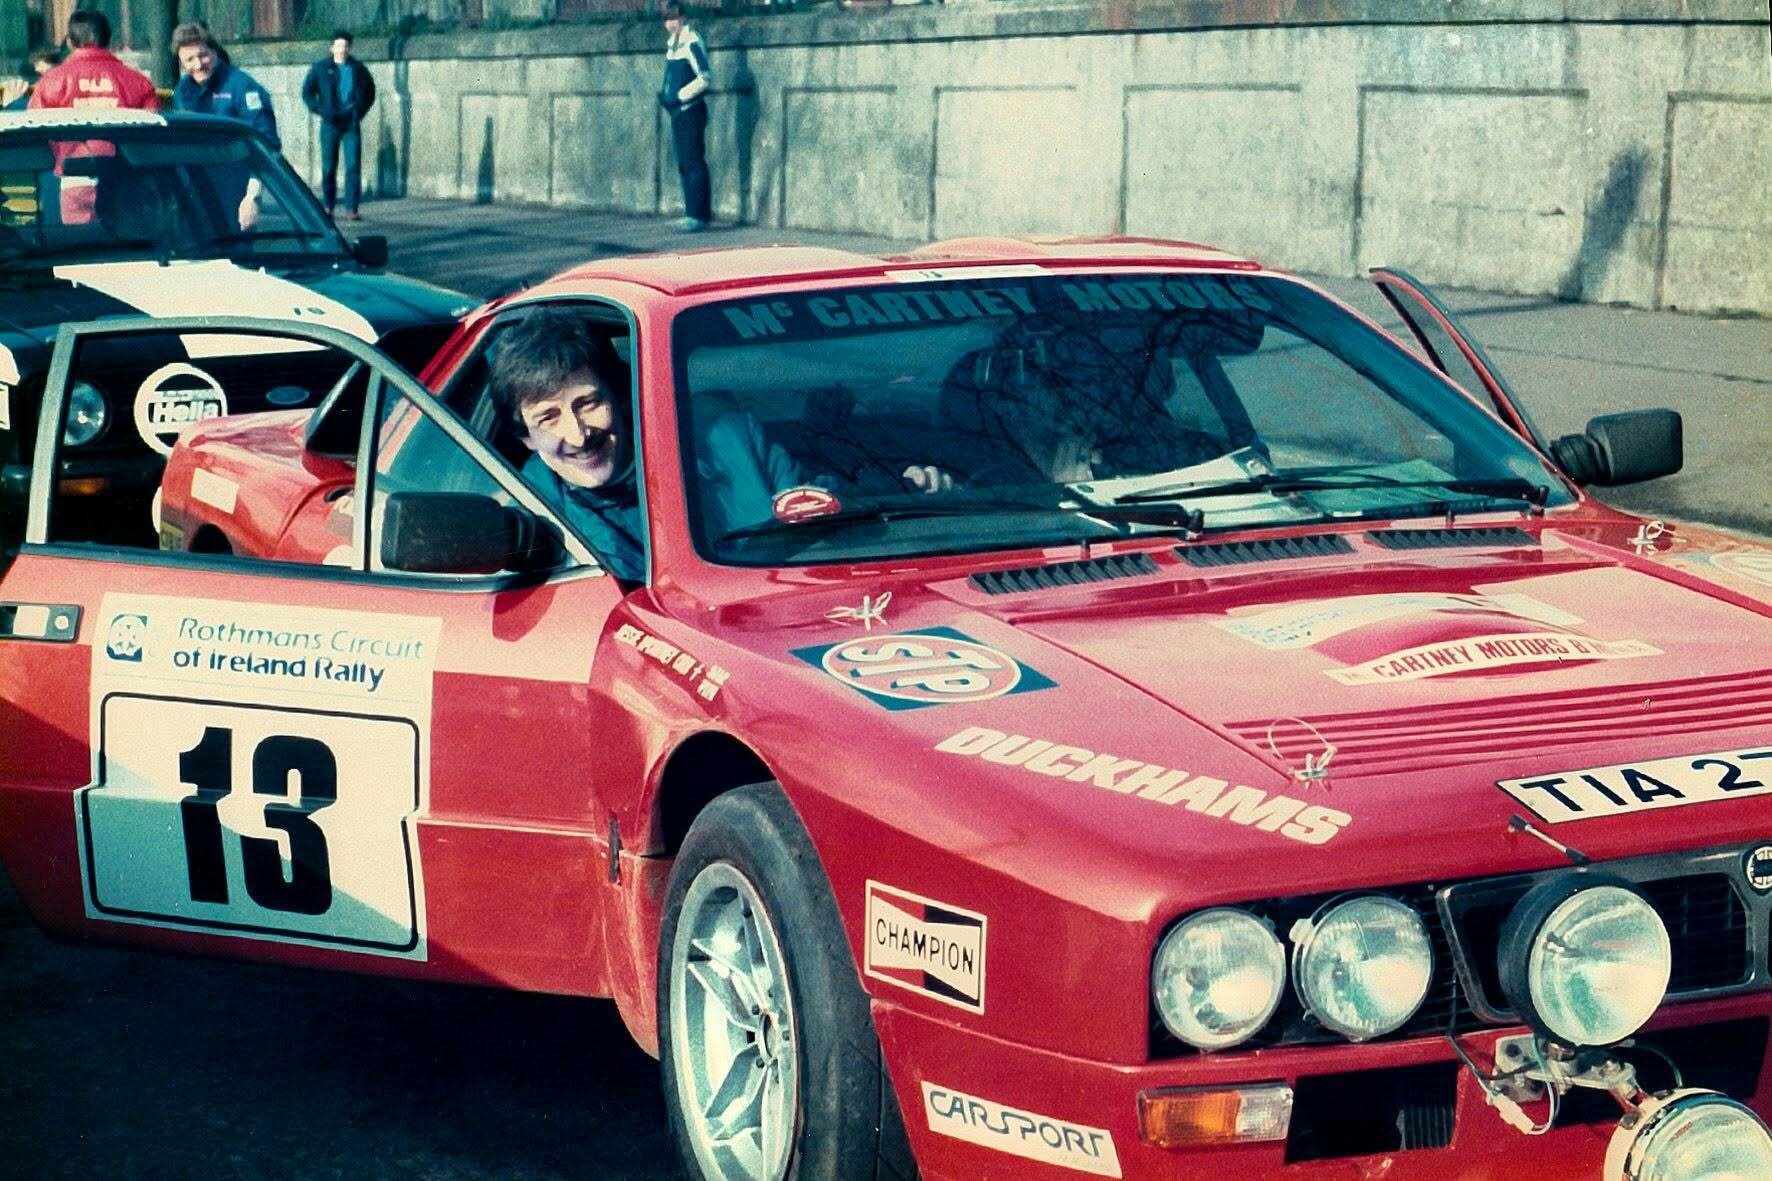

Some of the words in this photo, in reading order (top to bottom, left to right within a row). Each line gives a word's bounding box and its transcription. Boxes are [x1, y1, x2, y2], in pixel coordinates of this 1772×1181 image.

[808, 286, 1037, 327] CARTNEY
[1061, 281, 1272, 311] MOTORS
[179, 617, 322, 651] Rothmans
[331, 630, 423, 659] Circuit
[840, 638, 1003, 694] STP
[173, 648, 202, 668] of
[209, 649, 306, 677] Ireland
[314, 657, 385, 692] Rally
[934, 726, 1353, 845] DUCKHAMS
[1519, 768, 1686, 812] TIA
[178, 726, 338, 915] 13
[875, 917, 975, 976] CHAMPION
[929, 1090, 1104, 1158] CARSPORT
